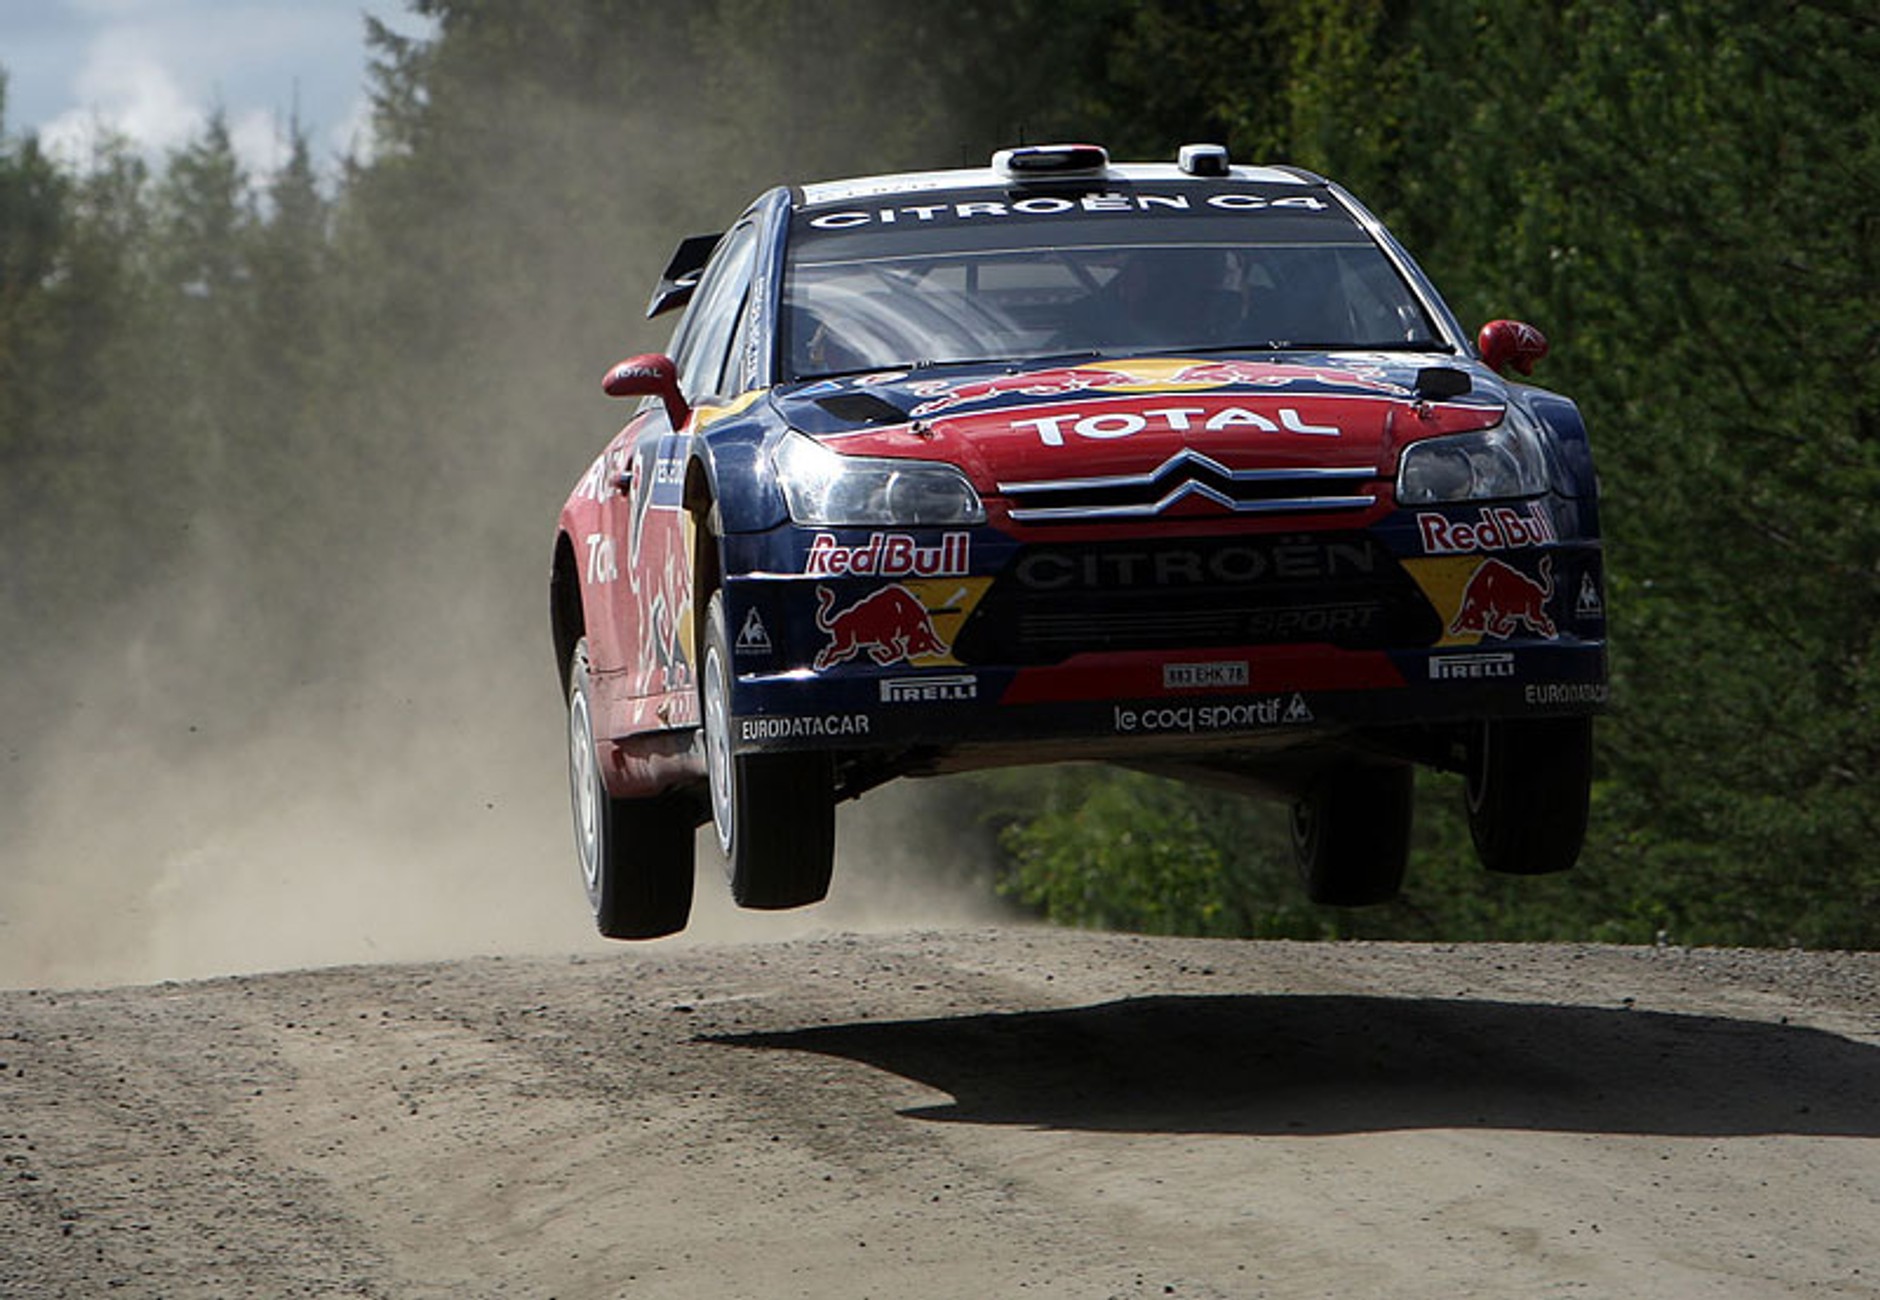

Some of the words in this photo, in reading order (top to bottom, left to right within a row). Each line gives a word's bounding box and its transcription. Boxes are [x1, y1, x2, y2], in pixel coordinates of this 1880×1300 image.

[811, 193, 1190, 228] CITROËN
[1206, 194, 1328, 212] C4
[1011, 407, 1341, 446] TOTAL
[1015, 536, 1375, 590] CITROËN
[1249, 607, 1377, 636] SPORT
[1429, 653, 1515, 678] PIRELLI
[880, 675, 978, 702] PIRELLI
[741, 714, 870, 740] EURODATACAR
[1114, 705, 1138, 730] le
[1142, 708, 1195, 733] coq
[1198, 698, 1281, 729] sportif
